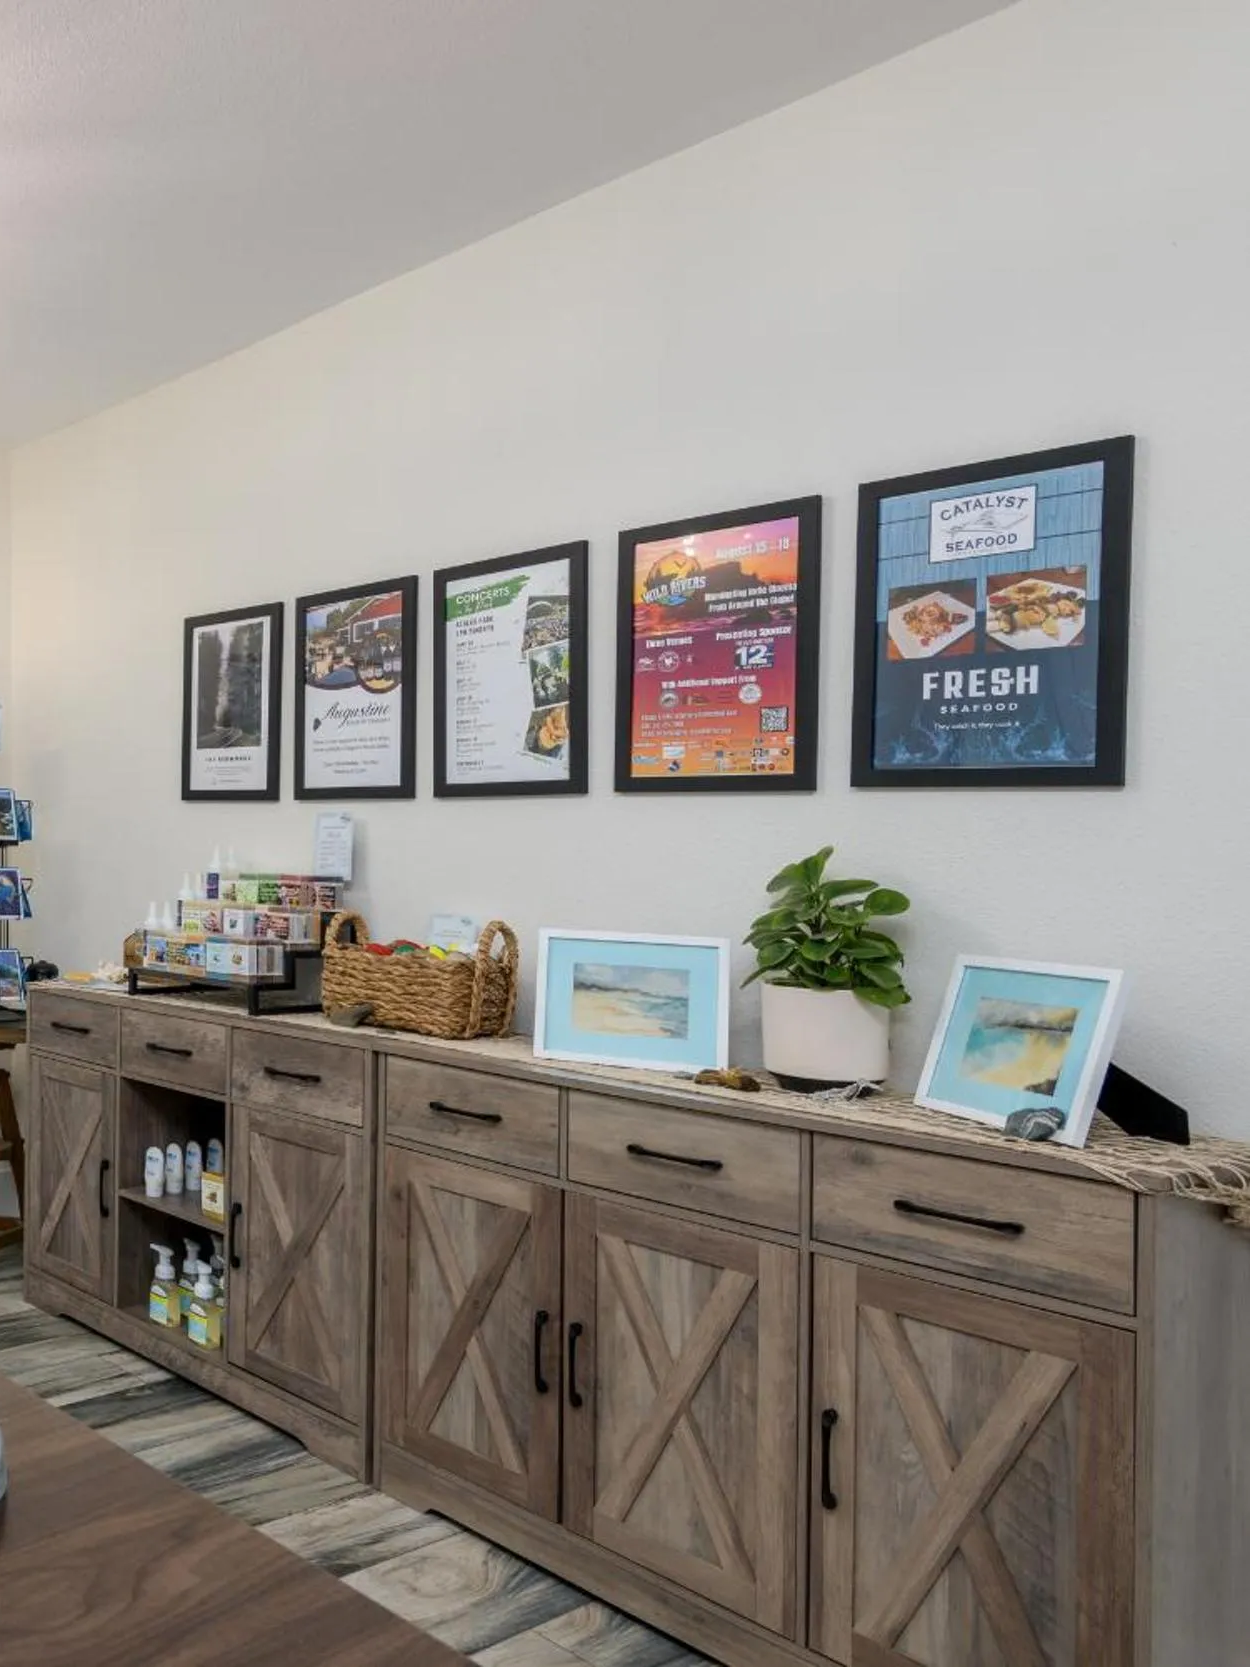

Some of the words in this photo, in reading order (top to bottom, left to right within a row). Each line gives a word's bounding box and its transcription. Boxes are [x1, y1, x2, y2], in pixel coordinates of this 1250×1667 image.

[940, 496, 1028, 521] CATALYST
[945, 533, 1018, 553] SEAFOOD
[456, 587, 510, 605] CONCERTS
[642, 583, 669, 603] WILD
[670, 576, 707, 594] RIVERS
[735, 645, 769, 666] 12
[922, 665, 1039, 700] FRESH
[939, 703, 1019, 714] SEAFOOD
